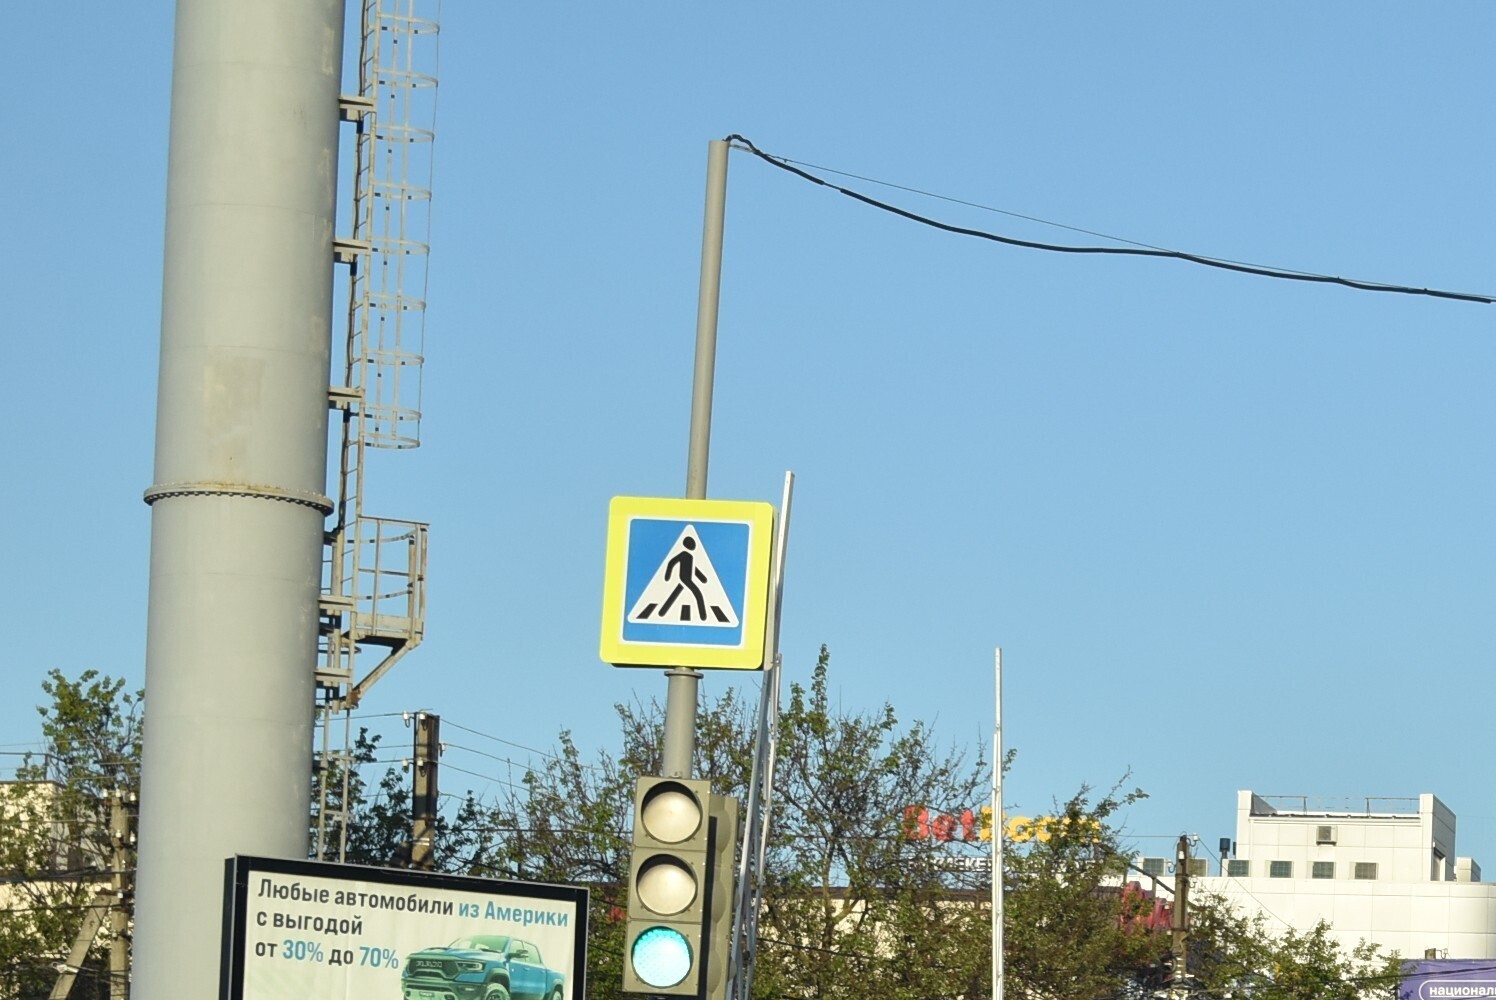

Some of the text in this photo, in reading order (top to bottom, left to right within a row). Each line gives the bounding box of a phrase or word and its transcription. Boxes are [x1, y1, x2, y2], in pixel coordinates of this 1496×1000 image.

[258, 878, 569, 928] Любые автомобили из Америки
[256, 911, 363, 936] с выгодой
[255, 939, 399, 969] от 30% до 70%
